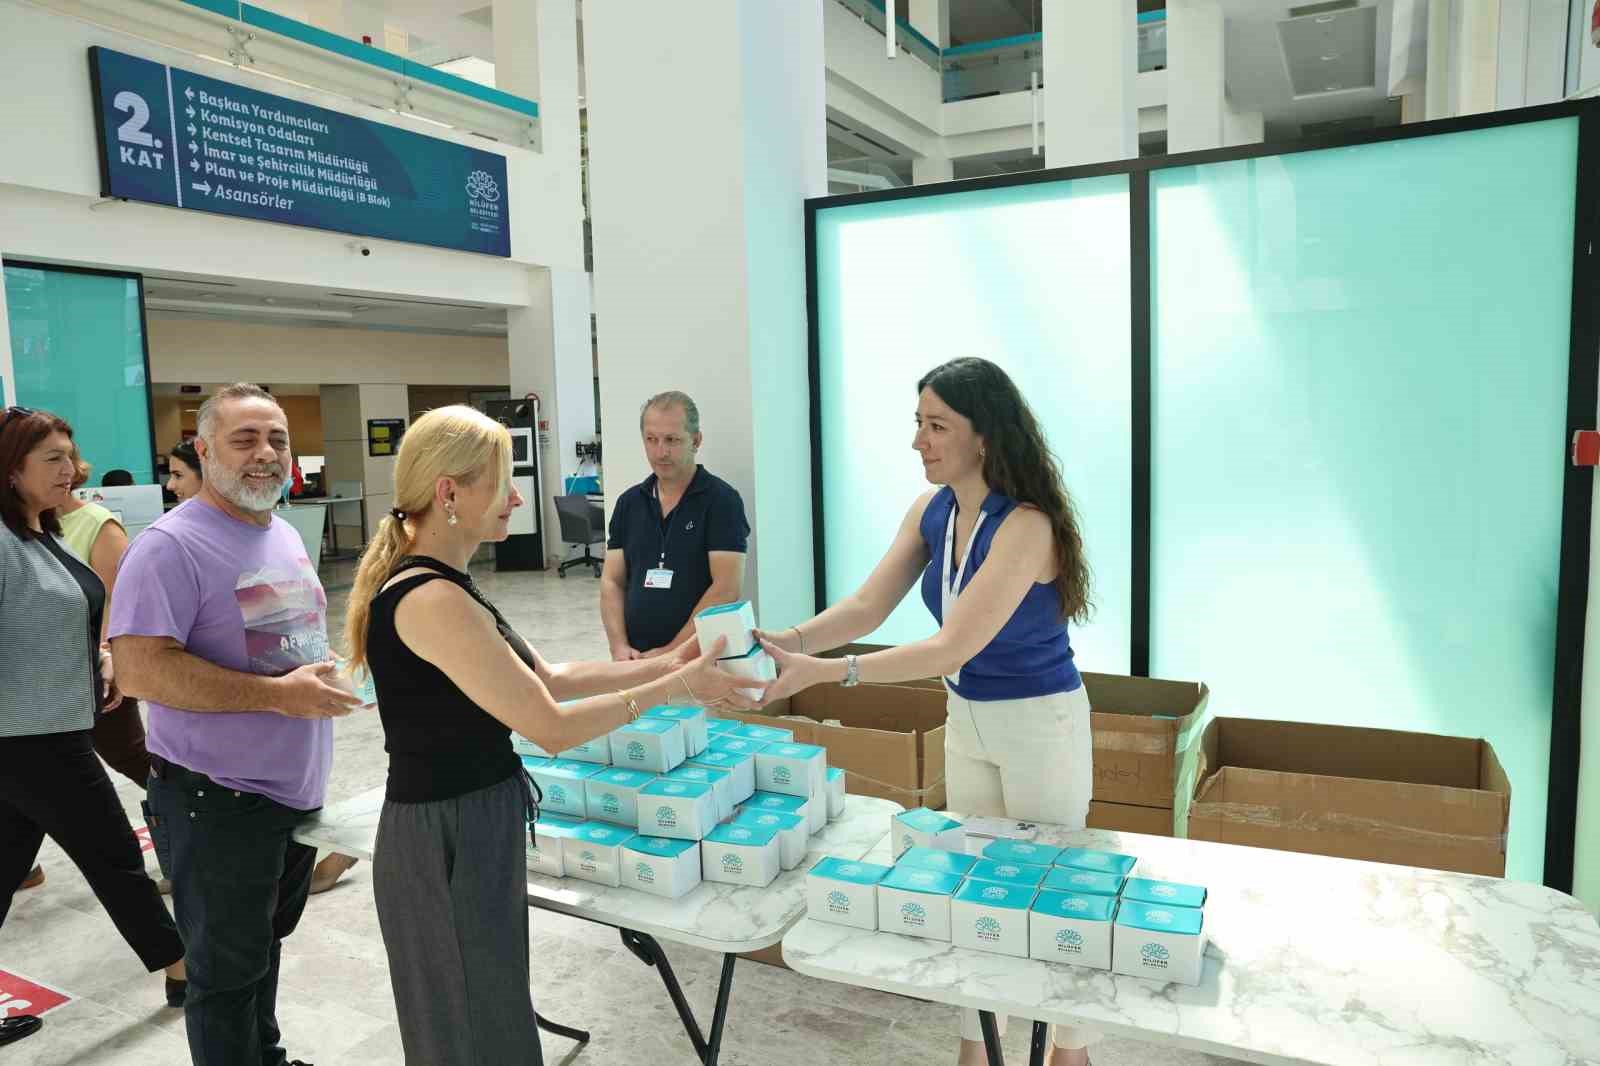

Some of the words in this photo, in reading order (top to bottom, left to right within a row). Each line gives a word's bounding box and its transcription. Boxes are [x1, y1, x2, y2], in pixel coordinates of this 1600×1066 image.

[113, 91, 163, 149] 2.
[200, 91, 250, 115] Başkan
[251, 104, 329, 134] Yardımcıları
[201, 108, 266, 135] Komisyon
[267, 125, 314, 146] Odaları
[119, 146, 164, 170] KAT
[202, 126, 253, 149] Kentsel
[254, 138, 305, 160] Tasarım
[307, 150, 369, 174] Müdürlüğü
[205, 161, 237, 179] Plan
[239, 170, 255, 182] ve
[257, 171, 289, 190] Proje
[292, 179, 354, 202] Müdürlüğü
[239, 154, 255, 165] ve
[257, 155, 315, 178] Şehircilik
[318, 167, 378, 191] Müdürlüğü
[214, 184, 295, 210] Asansörler
